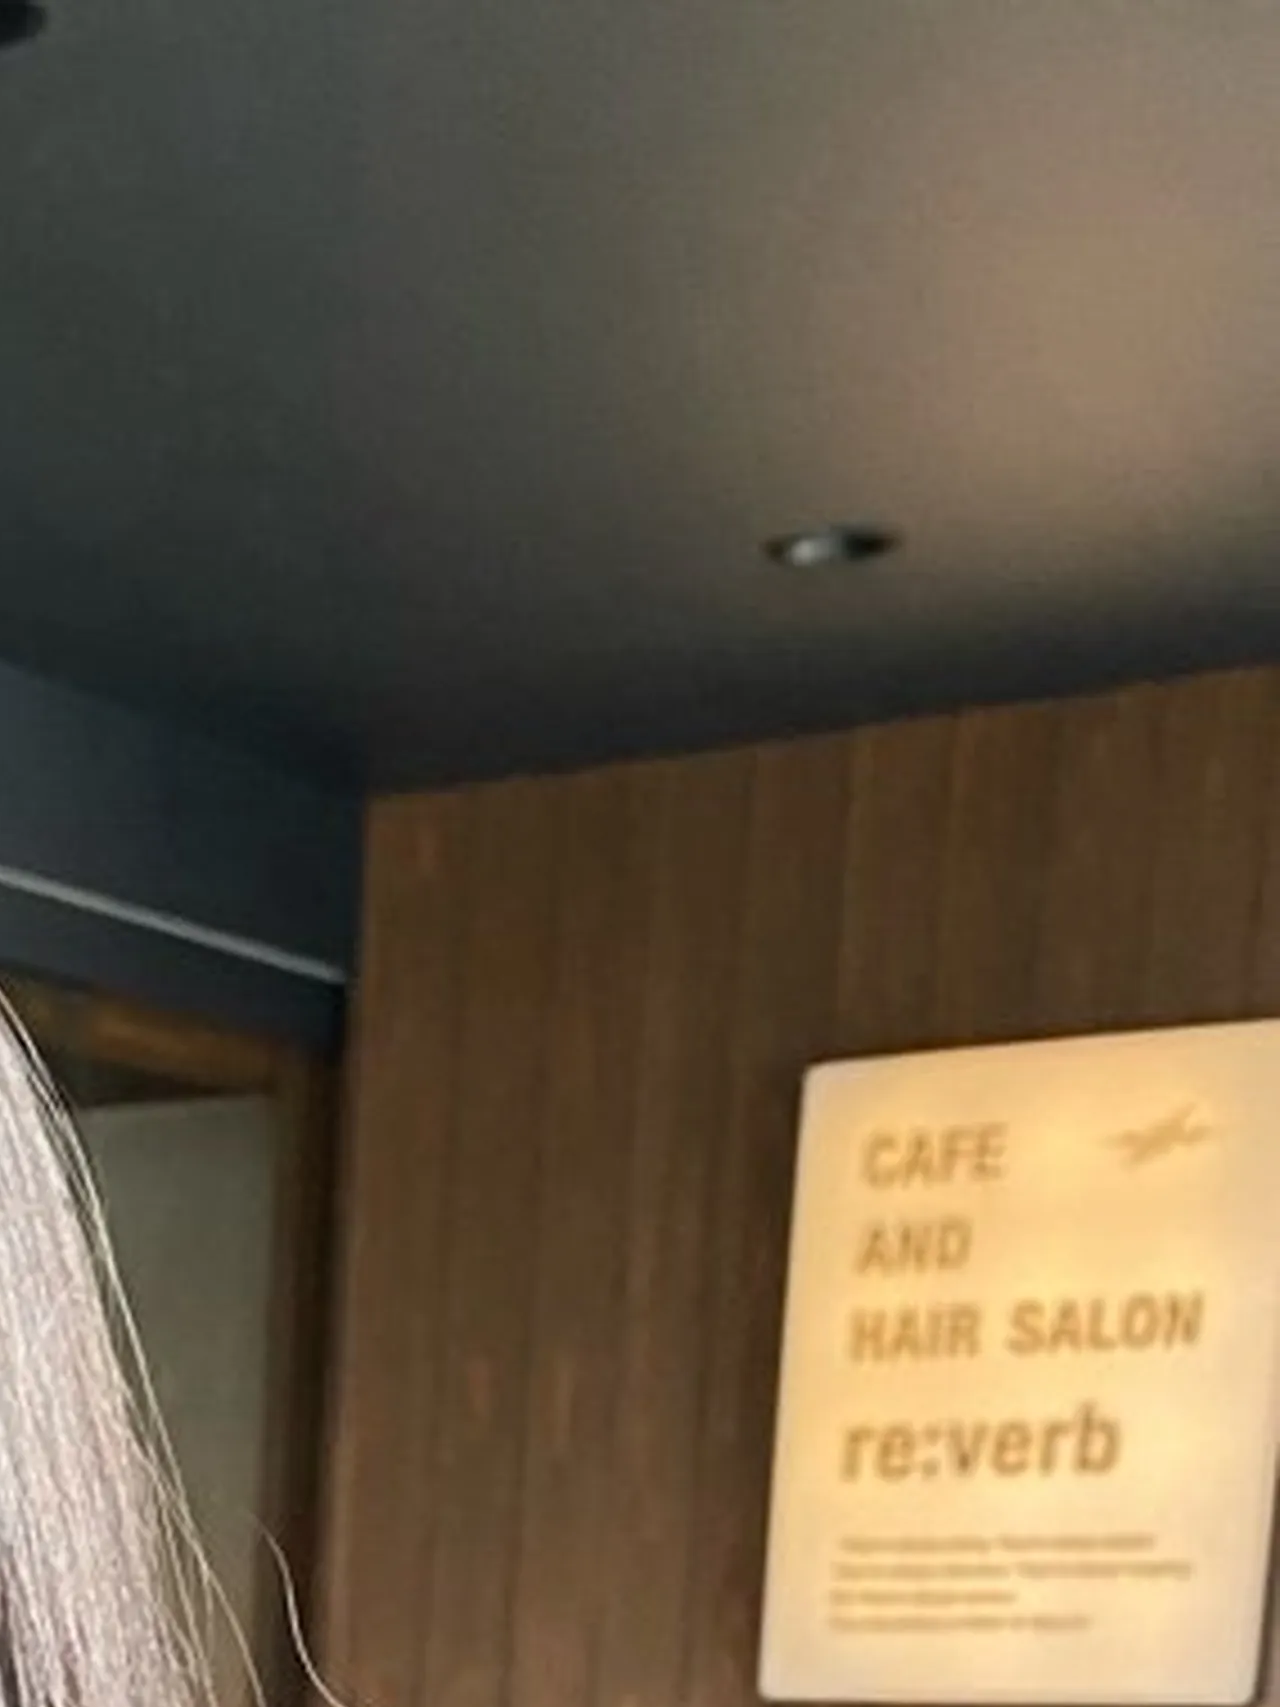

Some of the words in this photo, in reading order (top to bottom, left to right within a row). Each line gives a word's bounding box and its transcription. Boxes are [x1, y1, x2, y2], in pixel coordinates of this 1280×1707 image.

[860, 1121, 1011, 1190] CAFE
[853, 1215, 973, 1276] AND
[849, 1303, 982, 1363] HAIR
[1004, 1290, 1204, 1359] SALON
[840, 1399, 1122, 1482] re:verb
